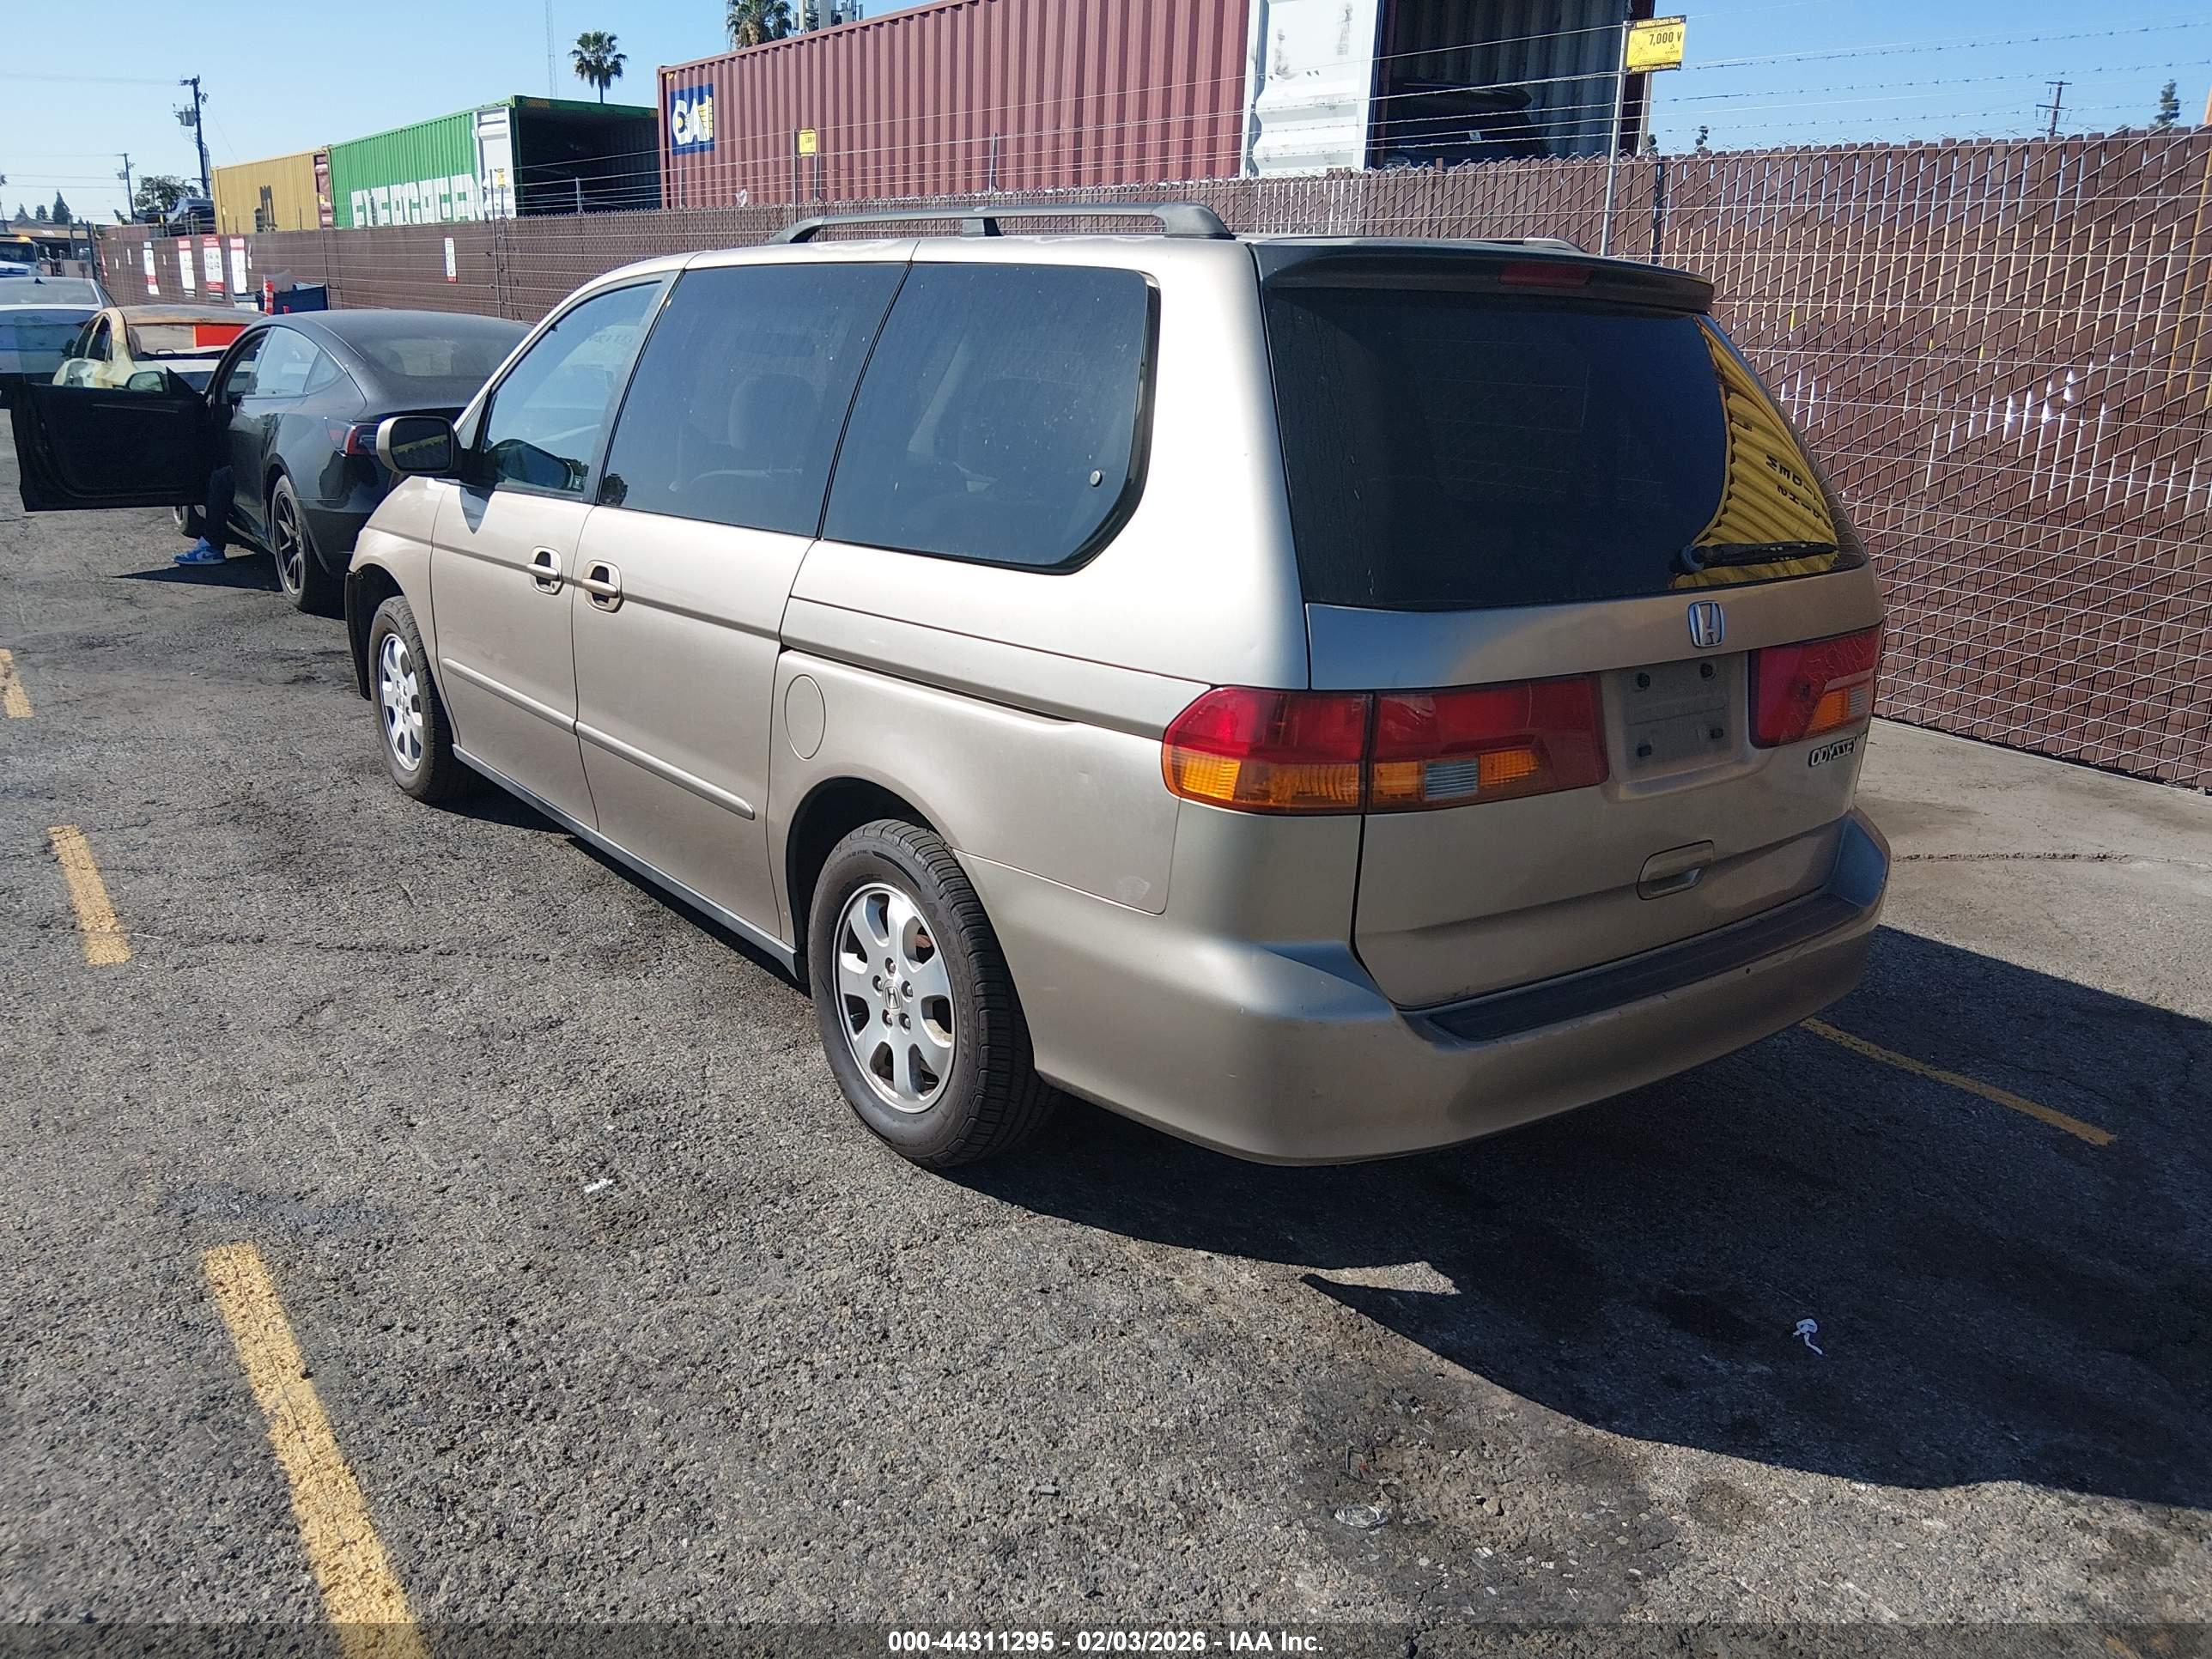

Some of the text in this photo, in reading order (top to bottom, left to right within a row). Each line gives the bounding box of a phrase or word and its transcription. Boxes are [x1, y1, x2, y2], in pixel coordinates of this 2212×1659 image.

[1649, 31, 1682, 46] 7,000 V
[672, 94, 713, 145] CAI
